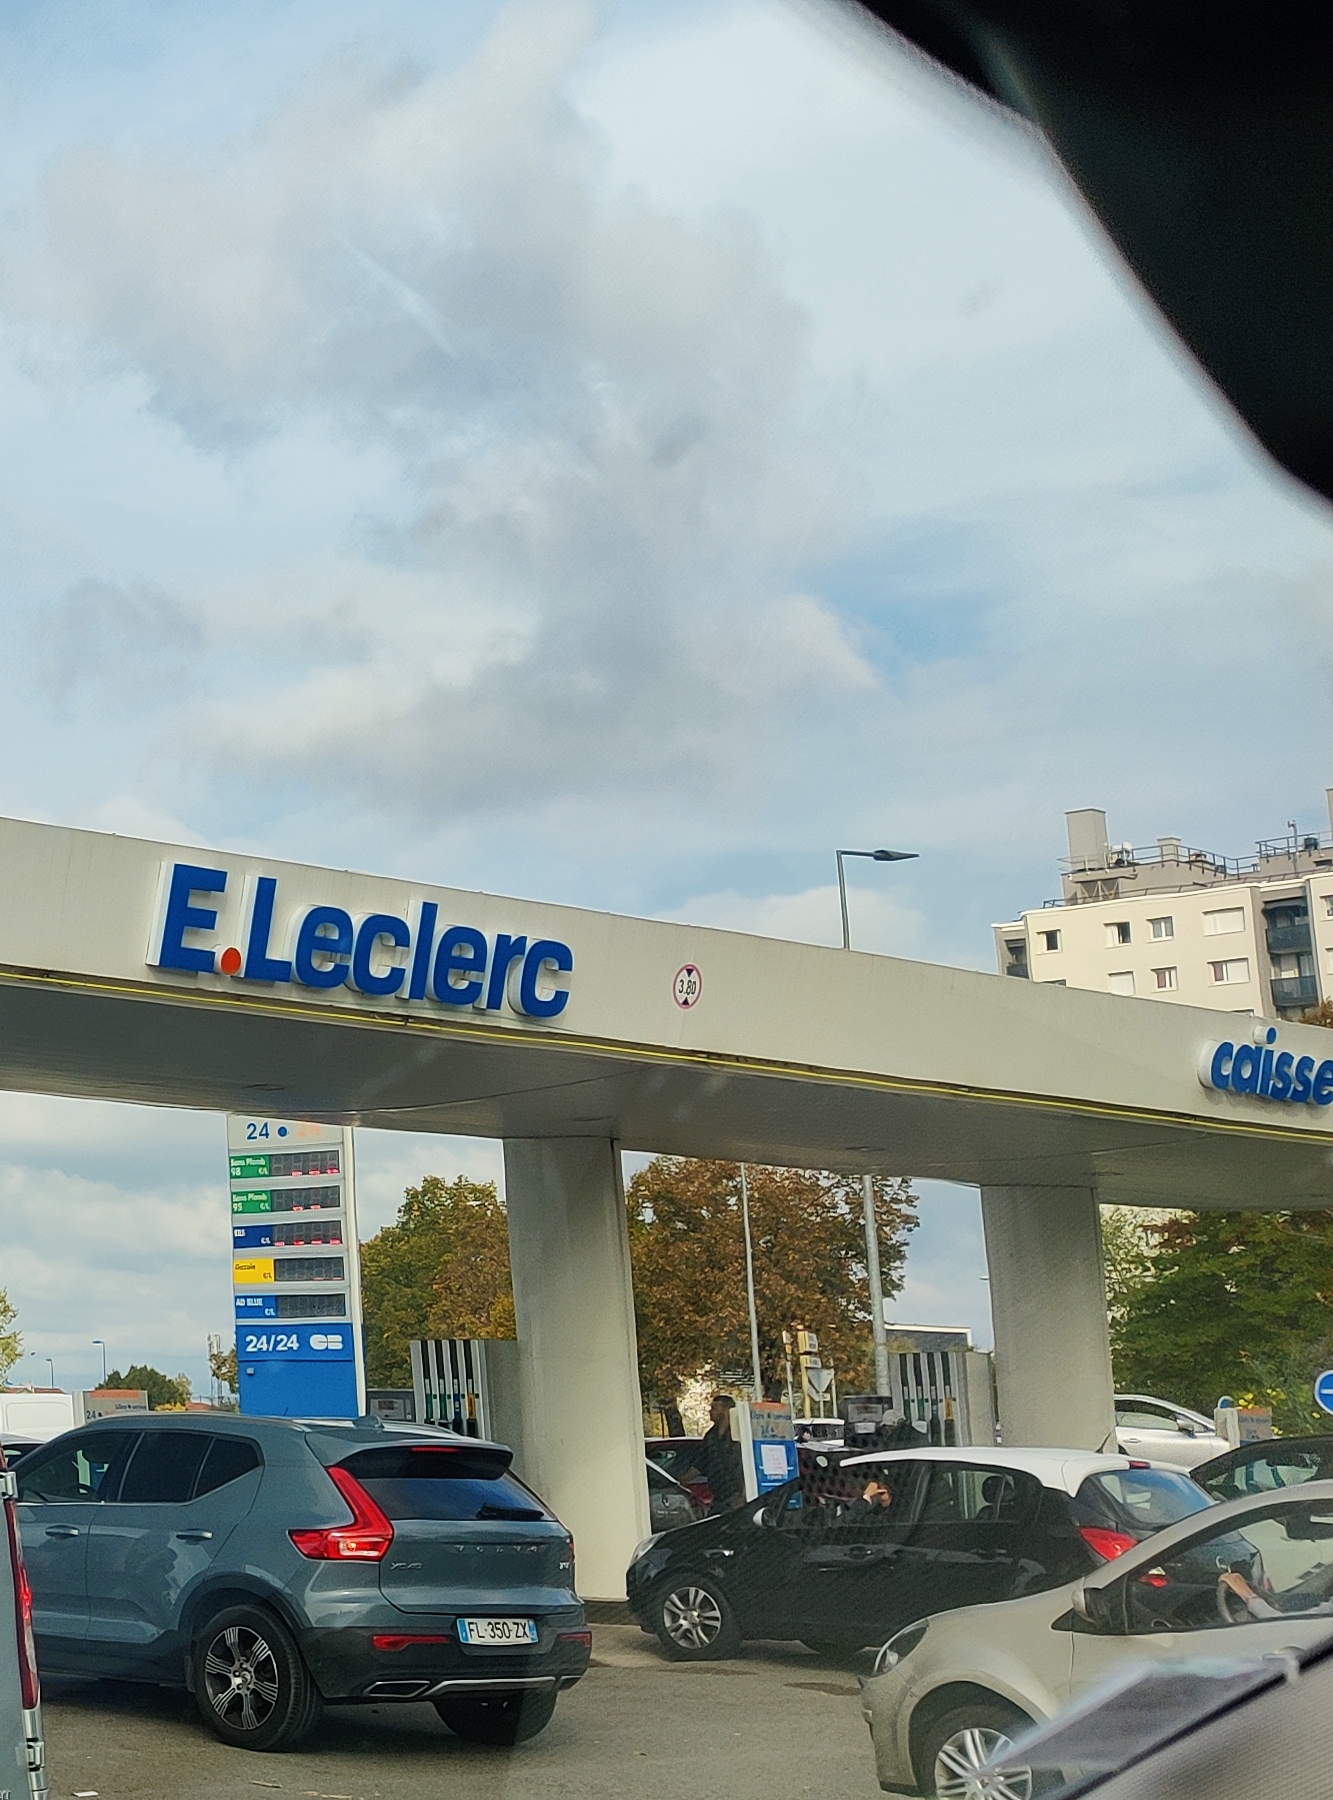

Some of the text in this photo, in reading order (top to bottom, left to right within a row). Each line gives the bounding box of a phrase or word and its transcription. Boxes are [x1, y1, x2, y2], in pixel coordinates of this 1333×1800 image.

[153, 863, 573, 1018] E.Leclerc
[678, 978, 697, 996] 3.80
[1209, 1026, 1333, 1106] caisse
[246, 1121, 270, 1140] 24
[245, 1333, 300, 1352] 24/24
